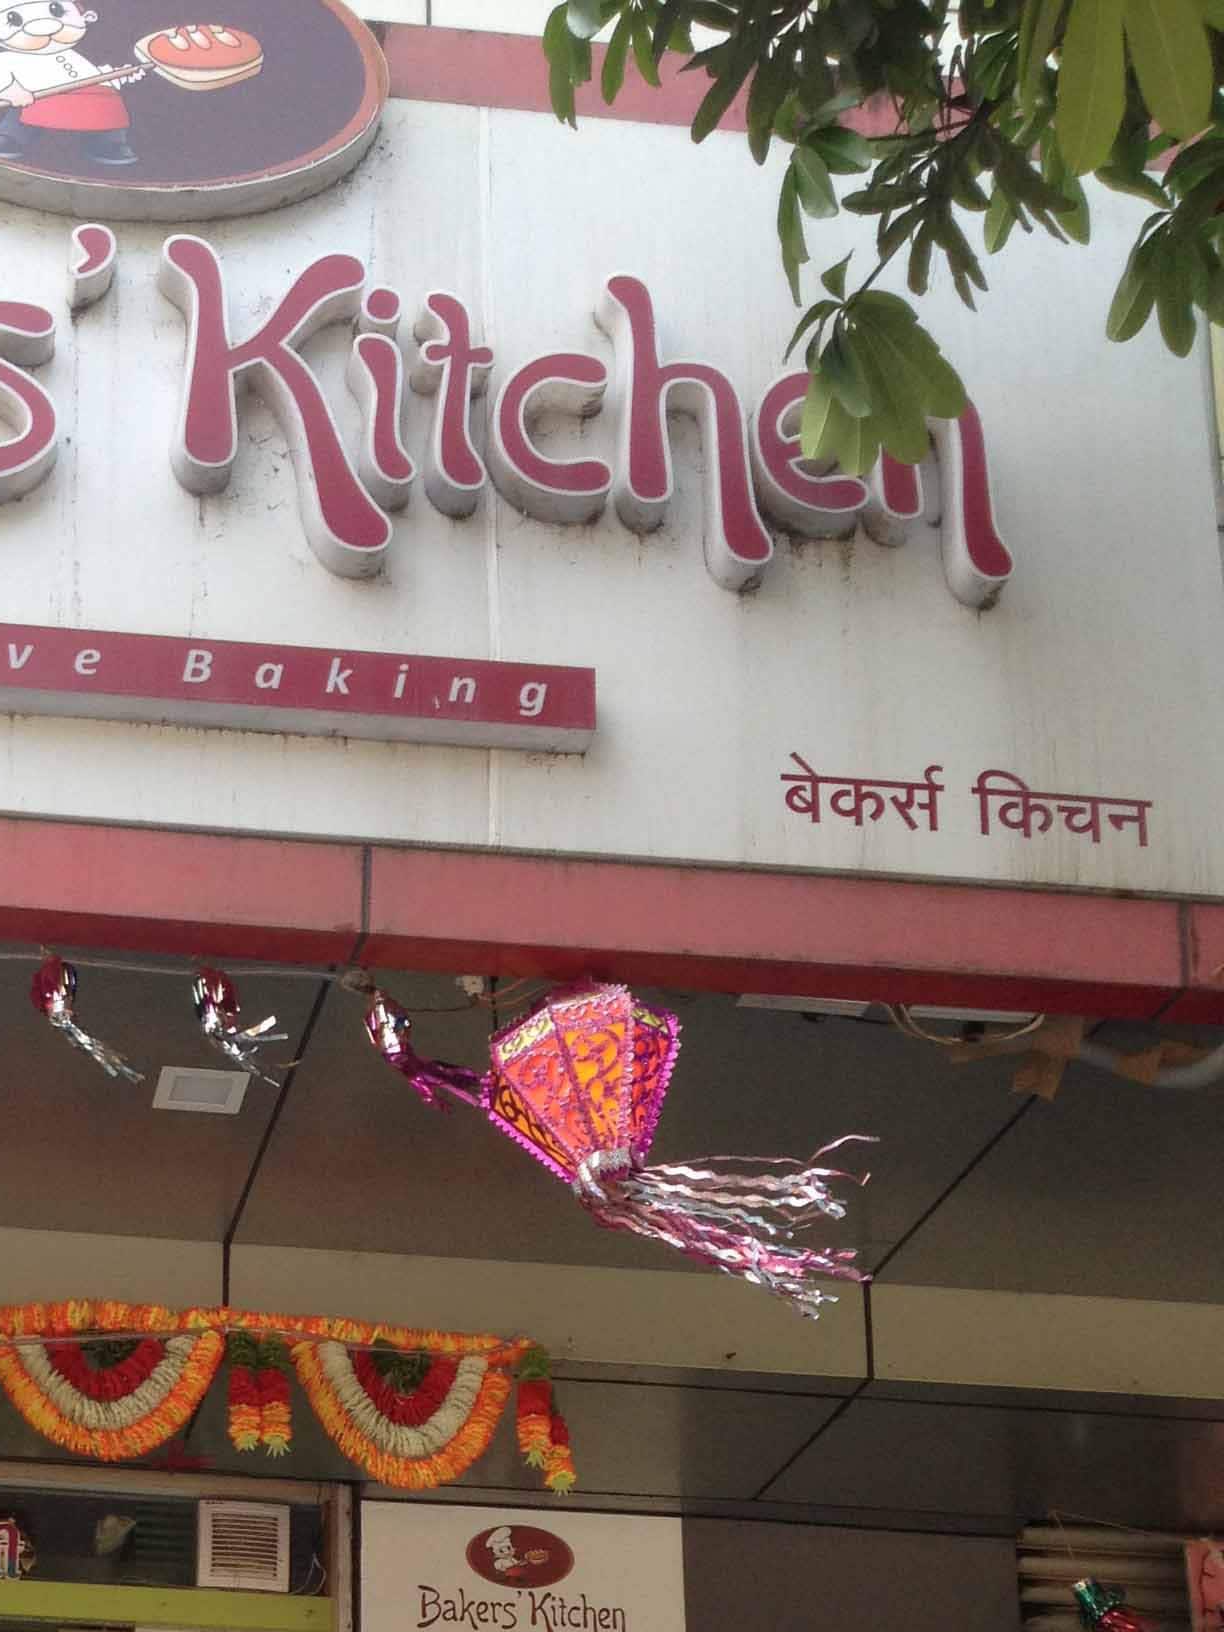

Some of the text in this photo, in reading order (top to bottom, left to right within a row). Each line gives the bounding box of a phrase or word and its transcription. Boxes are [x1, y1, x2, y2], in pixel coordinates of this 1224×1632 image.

[162, 234, 1015, 584] Kitchen
[181, 650, 549, 717] Baking
[780, 752, 1153, 848] बेकर्स किचन
[417, 1585, 522, 1631] Bakers'
